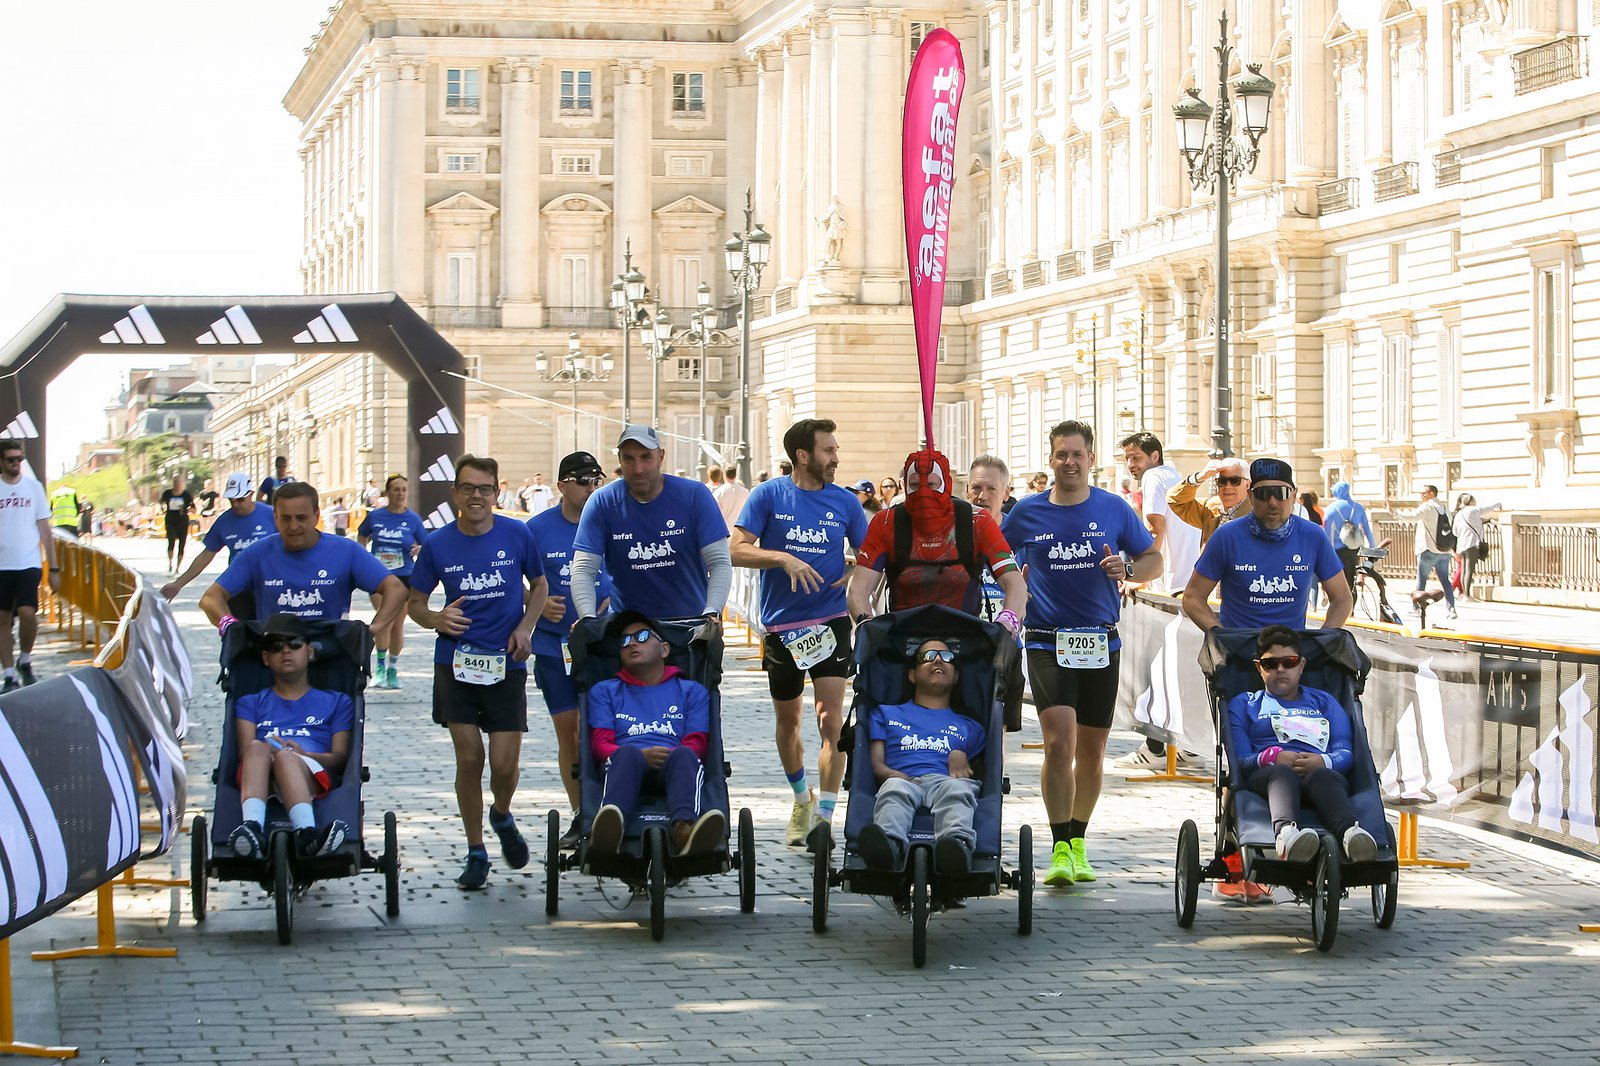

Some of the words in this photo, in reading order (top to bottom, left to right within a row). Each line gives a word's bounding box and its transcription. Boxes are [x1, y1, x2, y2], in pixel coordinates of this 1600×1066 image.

[919, 66, 955, 277] aefat
[775, 513, 795, 521] aefat
[660, 528, 685, 537] ZURICH
[1034, 533, 1054, 541] aefat
[490, 559, 514, 567] ZURICH
[444, 565, 464, 573] aefat
[1235, 564, 1257, 572] aefat
[1249, 596, 1295, 605] #Imparables
[1068, 637, 1096, 649] 9205
[464, 657, 491, 670] 8491
[940, 729, 965, 742] ZURICH
